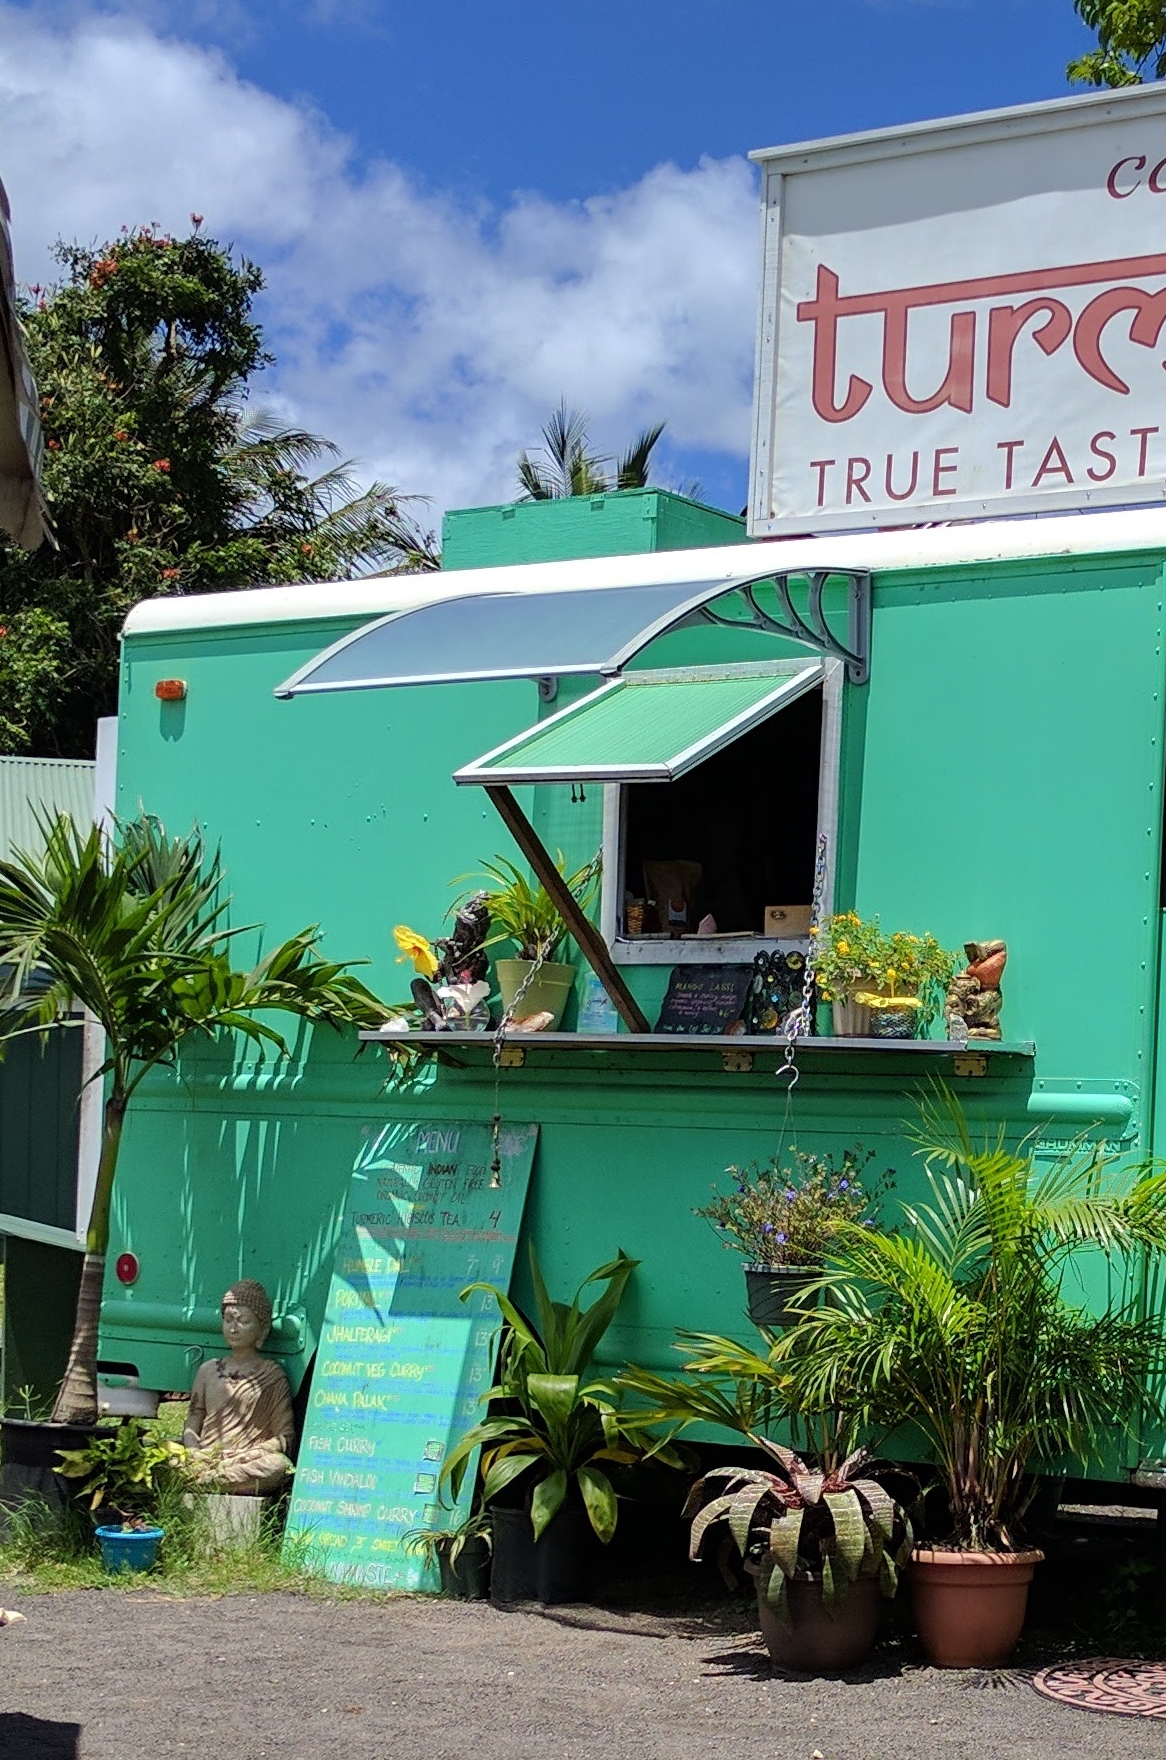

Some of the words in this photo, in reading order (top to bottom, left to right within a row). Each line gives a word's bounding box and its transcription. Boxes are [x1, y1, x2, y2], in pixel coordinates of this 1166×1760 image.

[809, 446, 960, 508] TRUE
[415, 1130, 461, 1155] MENU
[352, 1211, 392, 1227] TURMERIC
[440, 1211, 460, 1227] TEA
[366, 1361, 386, 1378] VEG
[389, 1361, 425, 1381] CURRY
[308, 1435, 332, 1450] FISH
[336, 1436, 377, 1458] CURRY
[299, 1468, 325, 1484] FISH
[377, 1505, 419, 1526] CURRY
